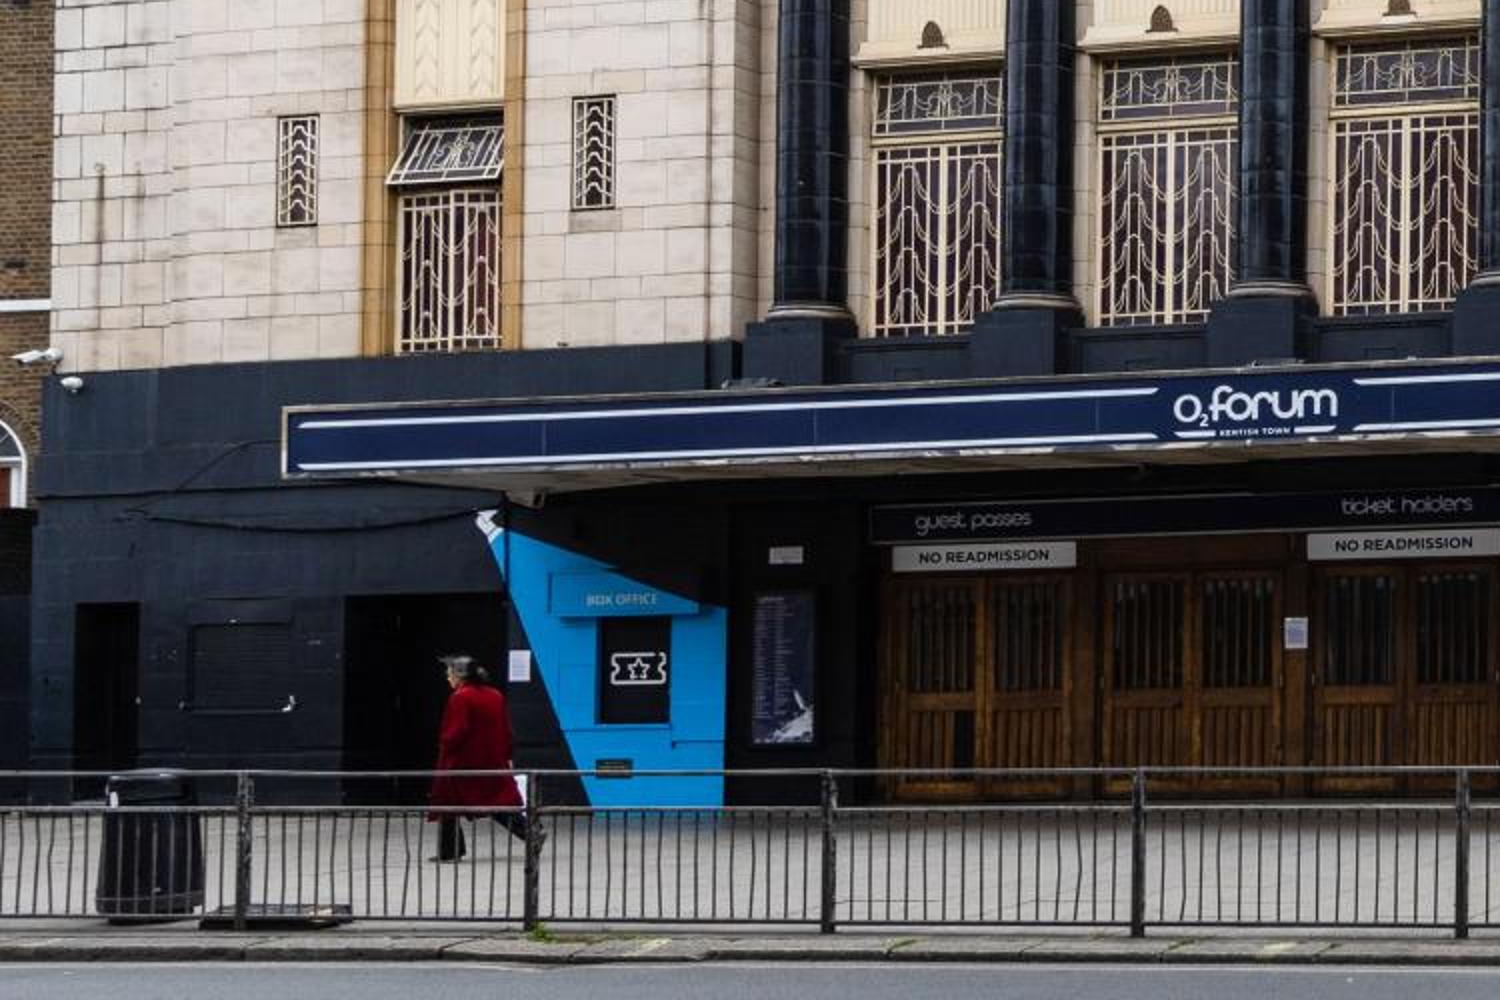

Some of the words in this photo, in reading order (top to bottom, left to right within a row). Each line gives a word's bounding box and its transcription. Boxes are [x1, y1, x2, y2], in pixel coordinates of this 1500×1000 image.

[1209, 384, 1339, 422] forum
[1219, 427, 1259, 437] KENTISH
[1262, 426, 1291, 436] TOWN
[1340, 496, 1395, 516] ticket
[1401, 494, 1473, 514] holders
[914, 512, 967, 537] guest
[970, 510, 1032, 531] passes
[1335, 539, 1358, 552] NO
[1364, 536, 1473, 551] READMISSION
[919, 551, 941, 565] NO
[945, 548, 1049, 564] READMISSION
[586, 594, 613, 607] BOX
[615, 593, 657, 606] OFFICE
